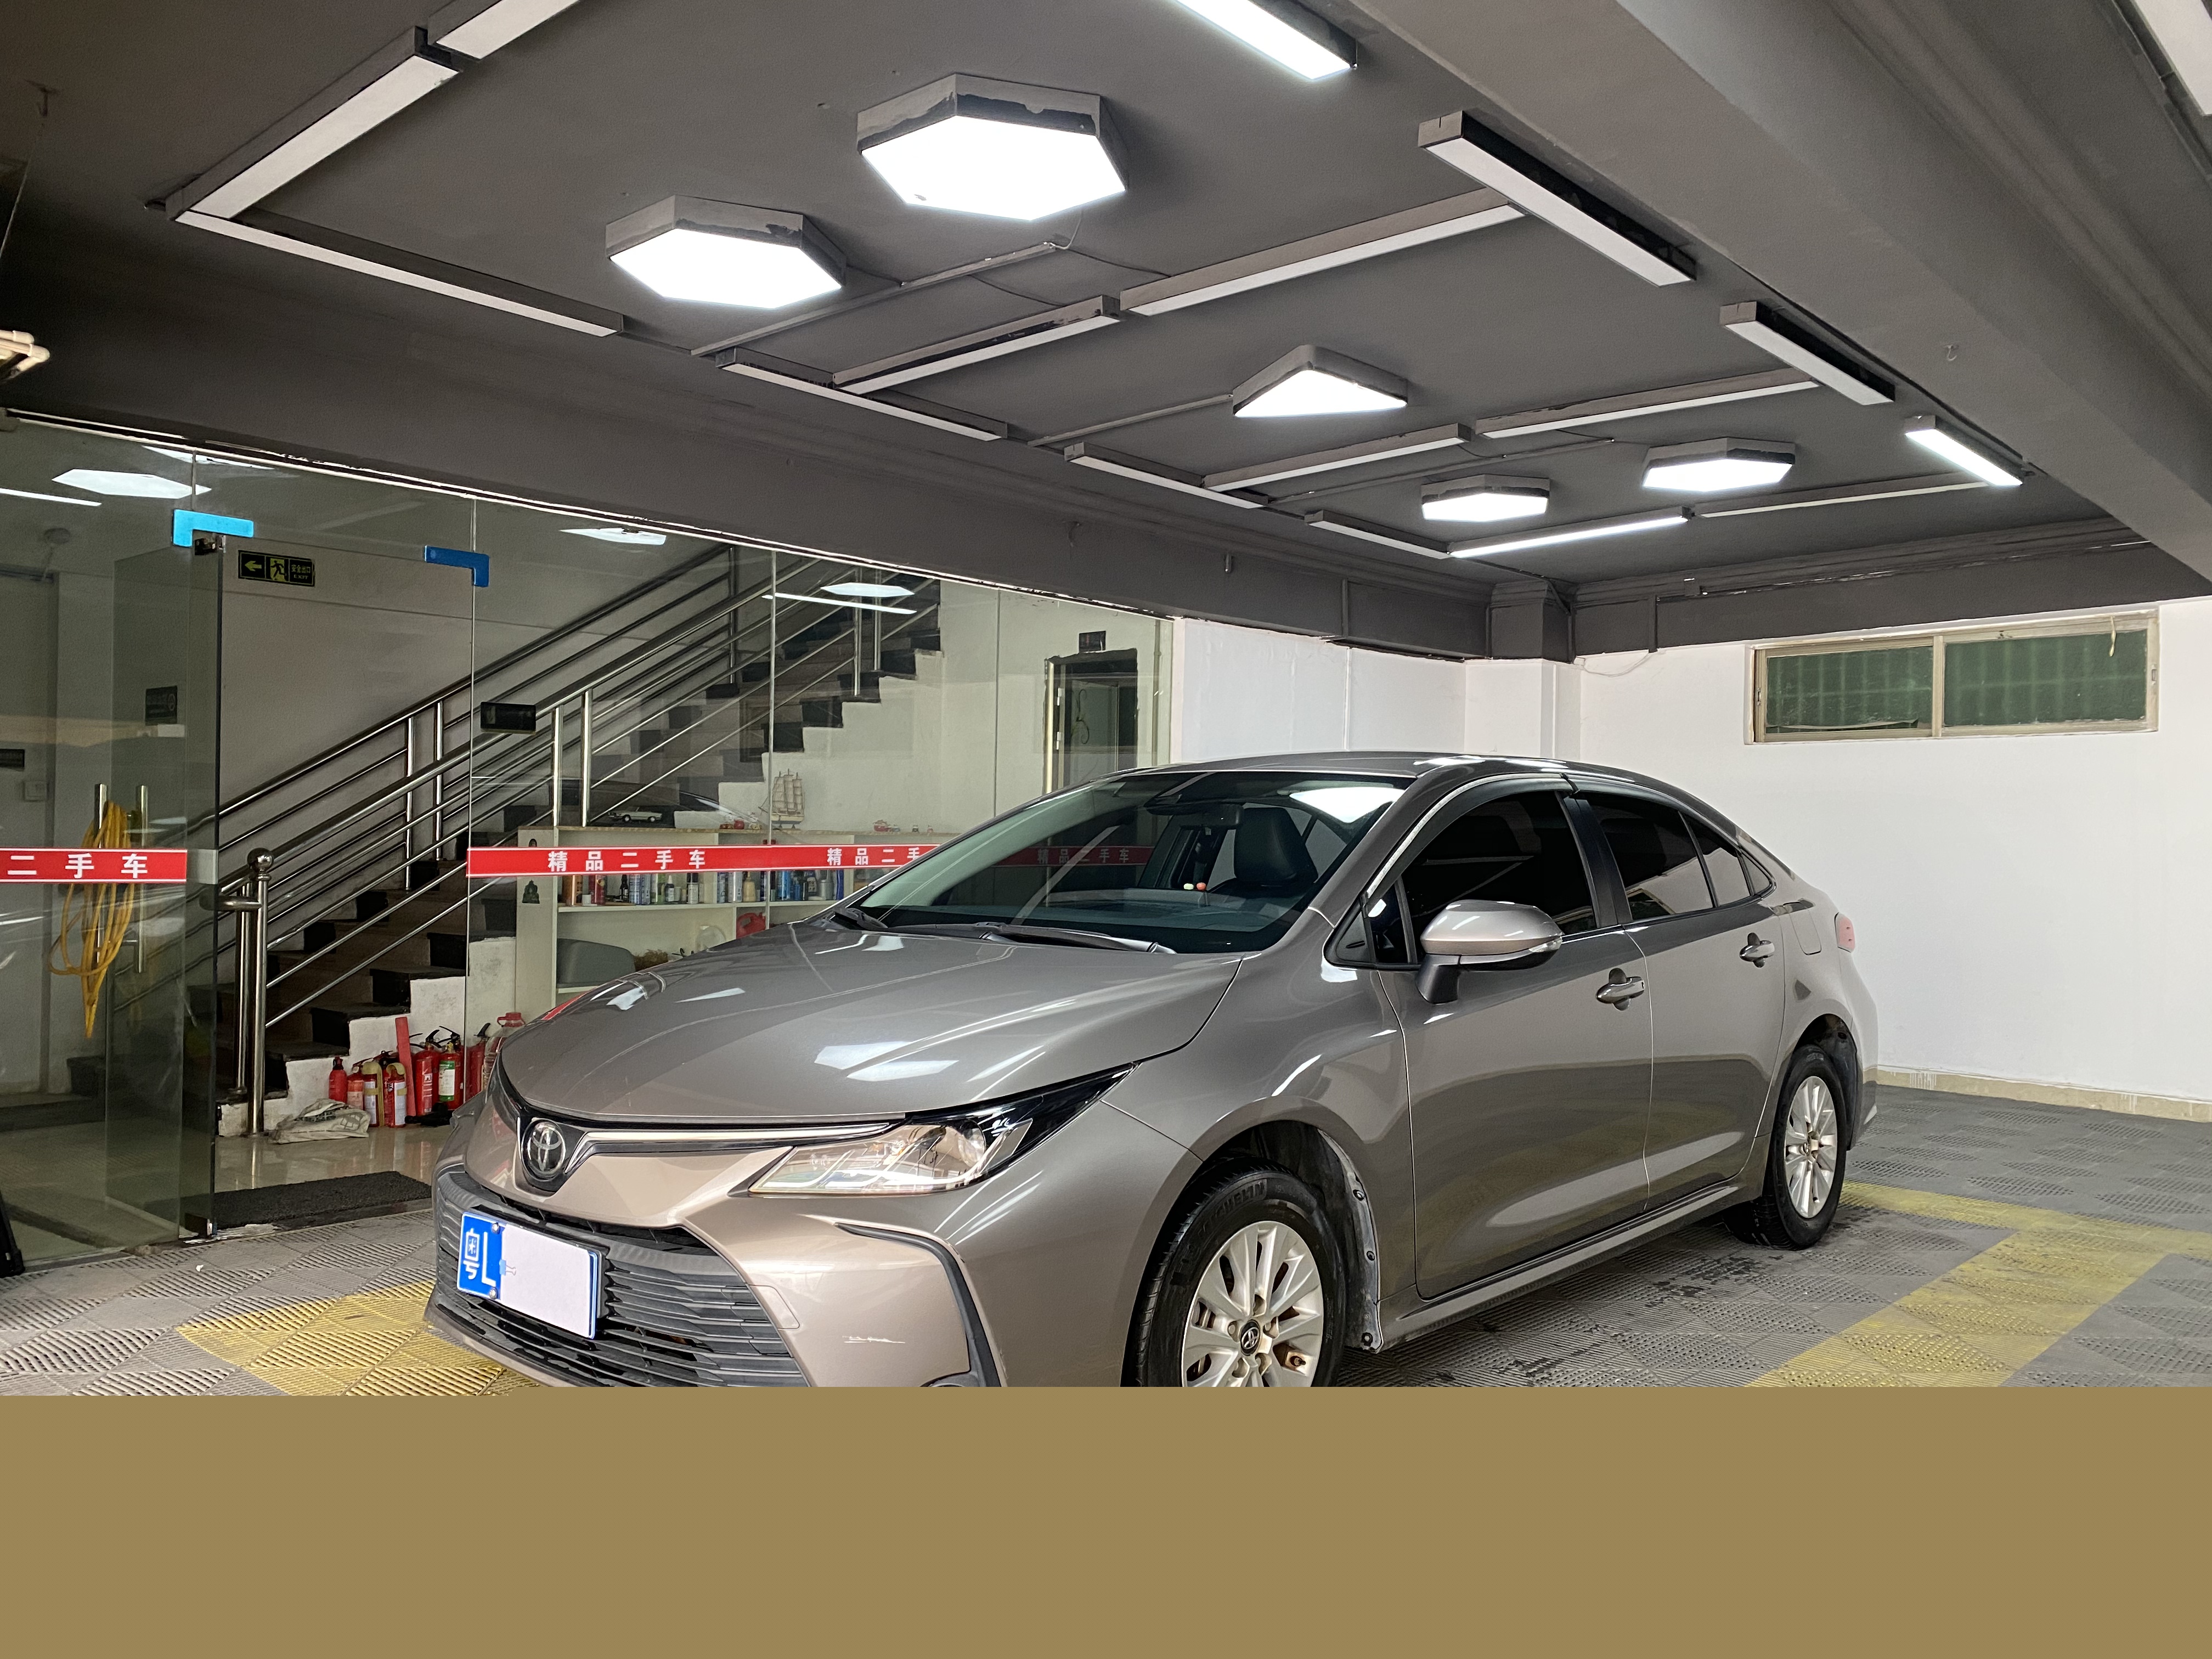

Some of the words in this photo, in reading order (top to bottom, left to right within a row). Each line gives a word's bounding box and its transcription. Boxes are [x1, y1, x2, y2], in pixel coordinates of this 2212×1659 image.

[7, 853, 148, 879] 二手车
[548, 849, 706, 873] 精品二手车
[827, 847, 920, 866] 精品二手
